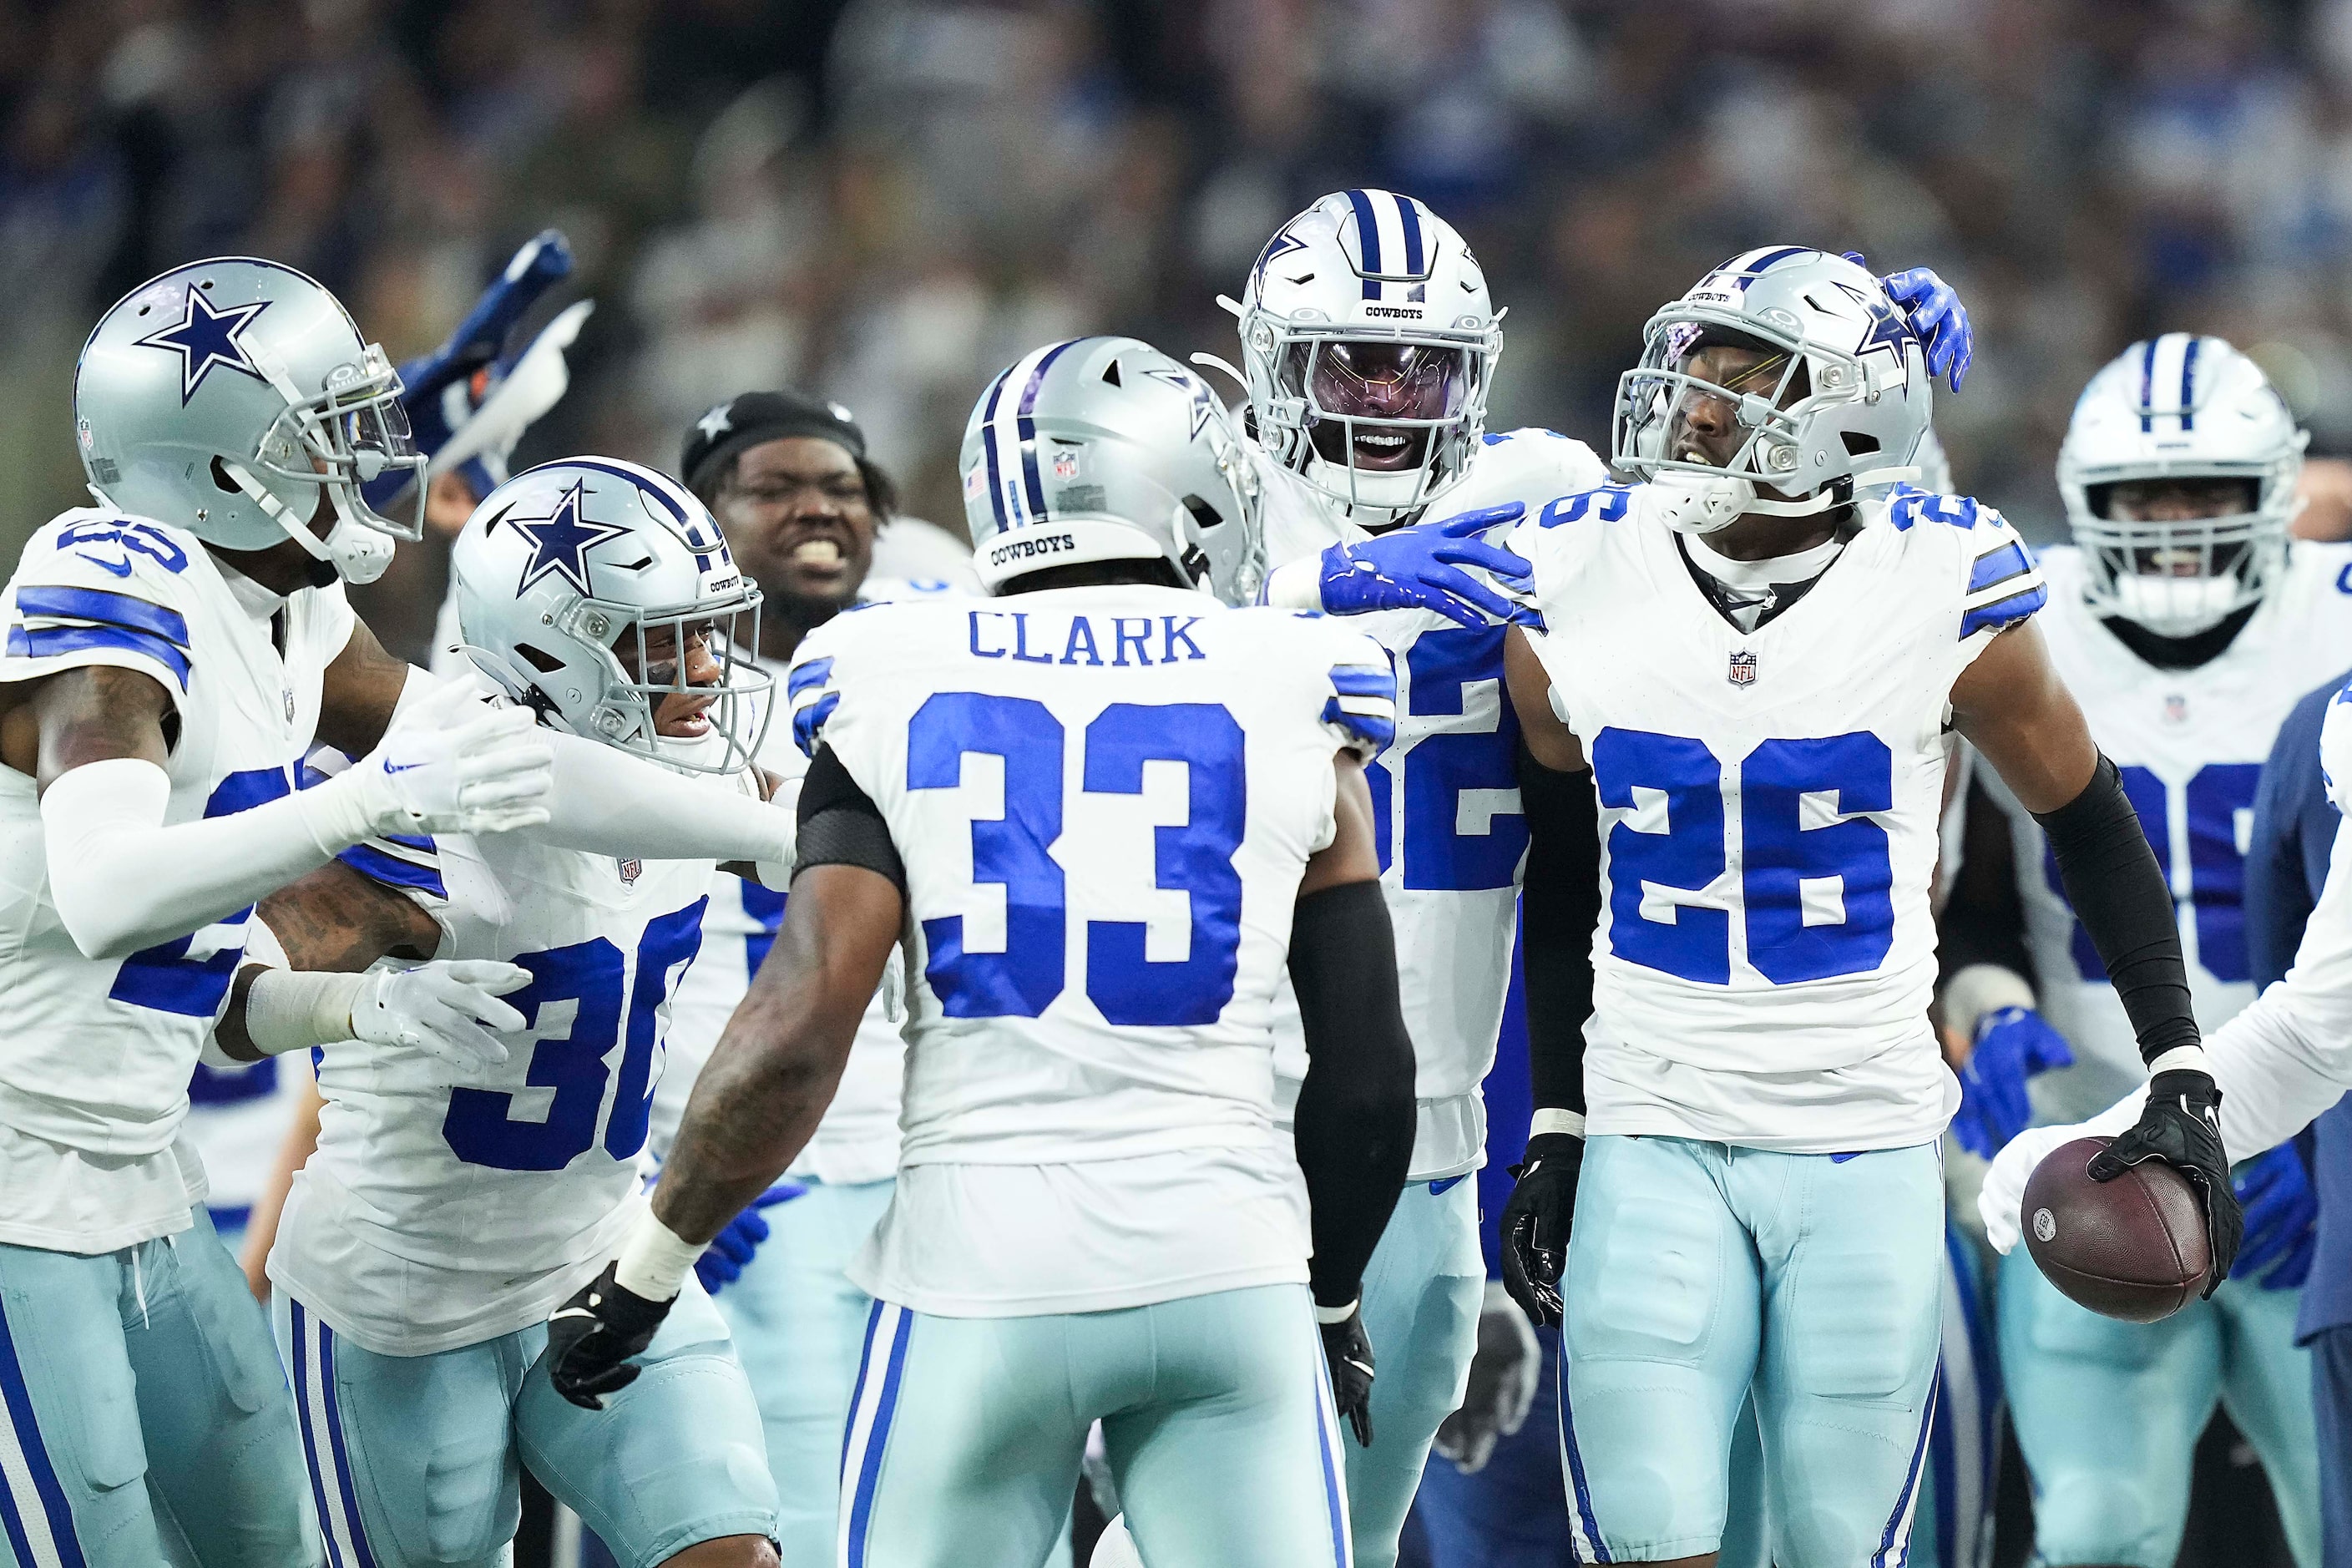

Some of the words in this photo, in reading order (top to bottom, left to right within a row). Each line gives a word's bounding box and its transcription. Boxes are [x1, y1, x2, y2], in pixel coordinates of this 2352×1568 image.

[1365, 306, 1423, 320] COWBOYS
[1688, 292, 1731, 302] COWBOYS
[991, 534, 1075, 566] COWBOYS
[969, 611, 1206, 667] CLARK
[1732, 665, 1753, 681] NFL
[1364, 625, 1531, 890] 2
[623, 861, 640, 878] NFL
[907, 691, 1246, 1025] 33
[1592, 726, 1895, 985] 26
